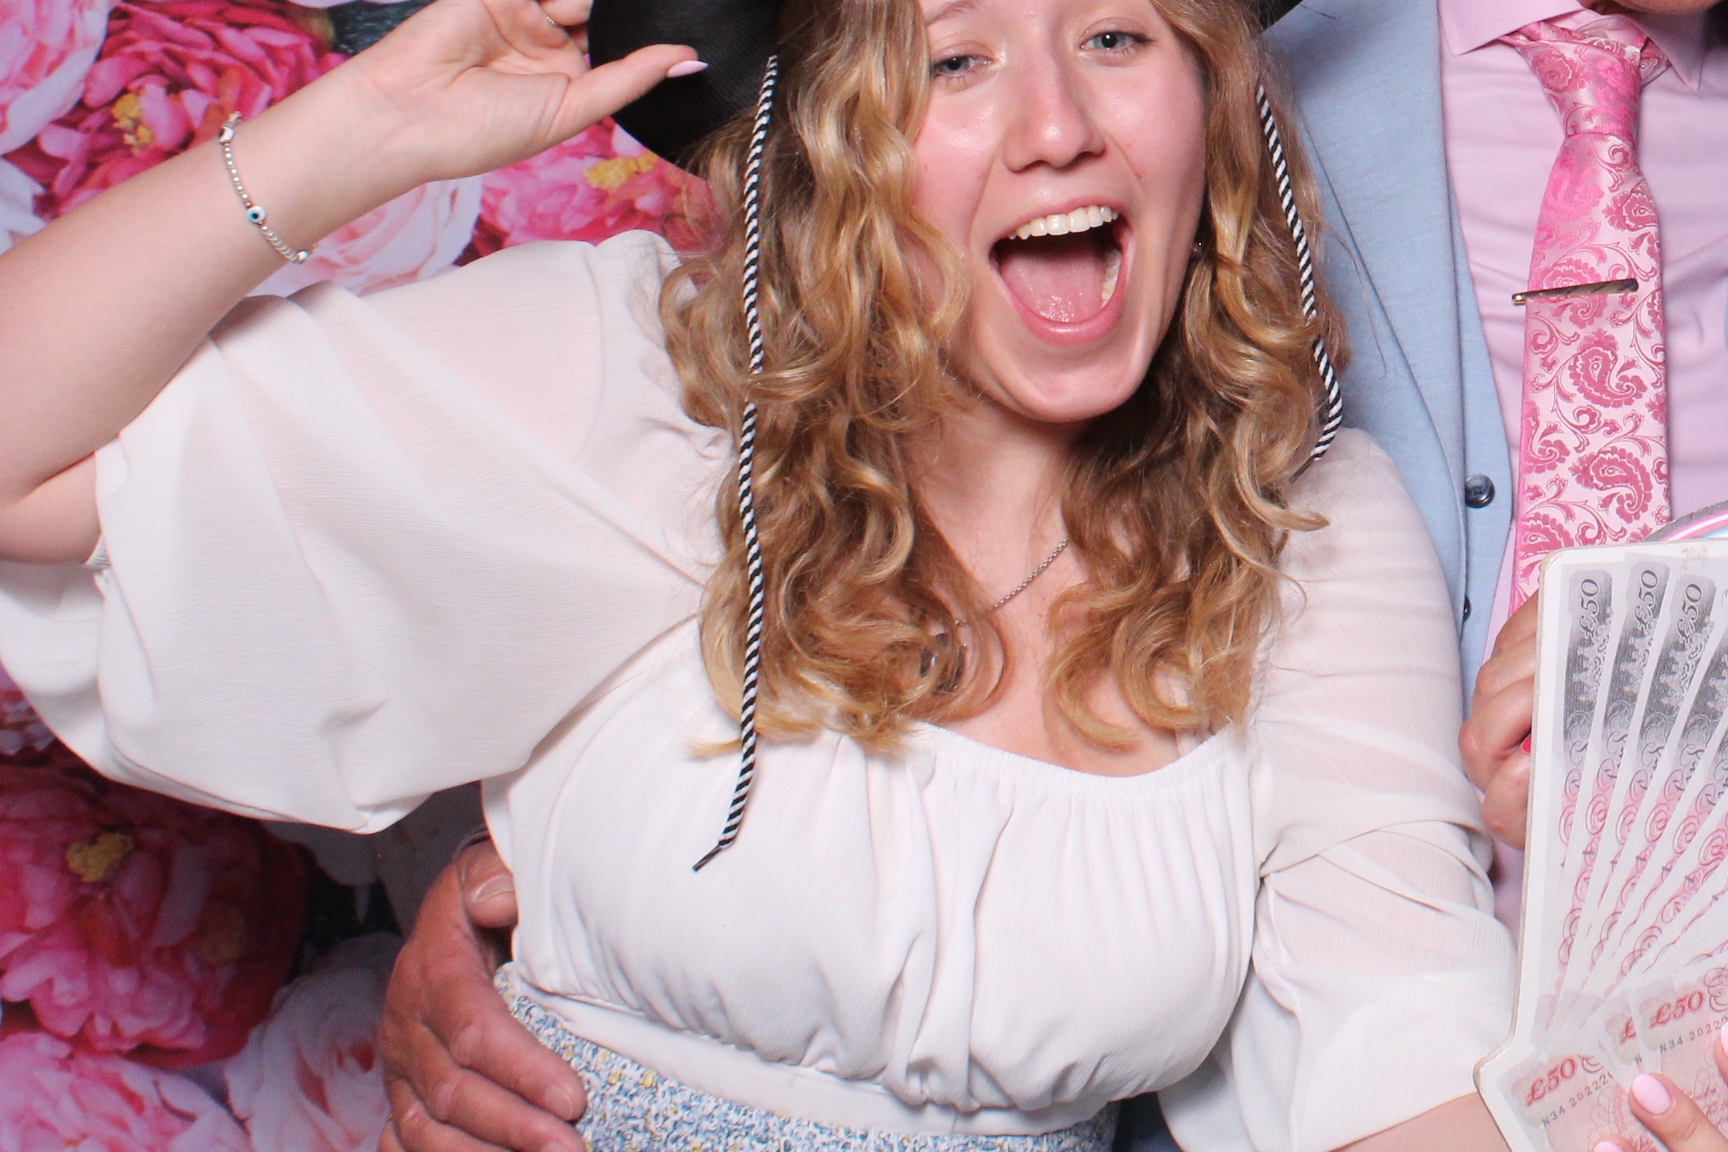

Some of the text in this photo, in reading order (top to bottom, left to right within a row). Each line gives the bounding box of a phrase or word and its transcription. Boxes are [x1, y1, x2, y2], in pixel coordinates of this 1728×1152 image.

[1578, 578, 1600, 642] £50
[1635, 568, 1659, 631] £50
[1677, 583, 1703, 646] £50
[1650, 990, 1706, 1029] £50
[1525, 1057, 1577, 1108] £50
